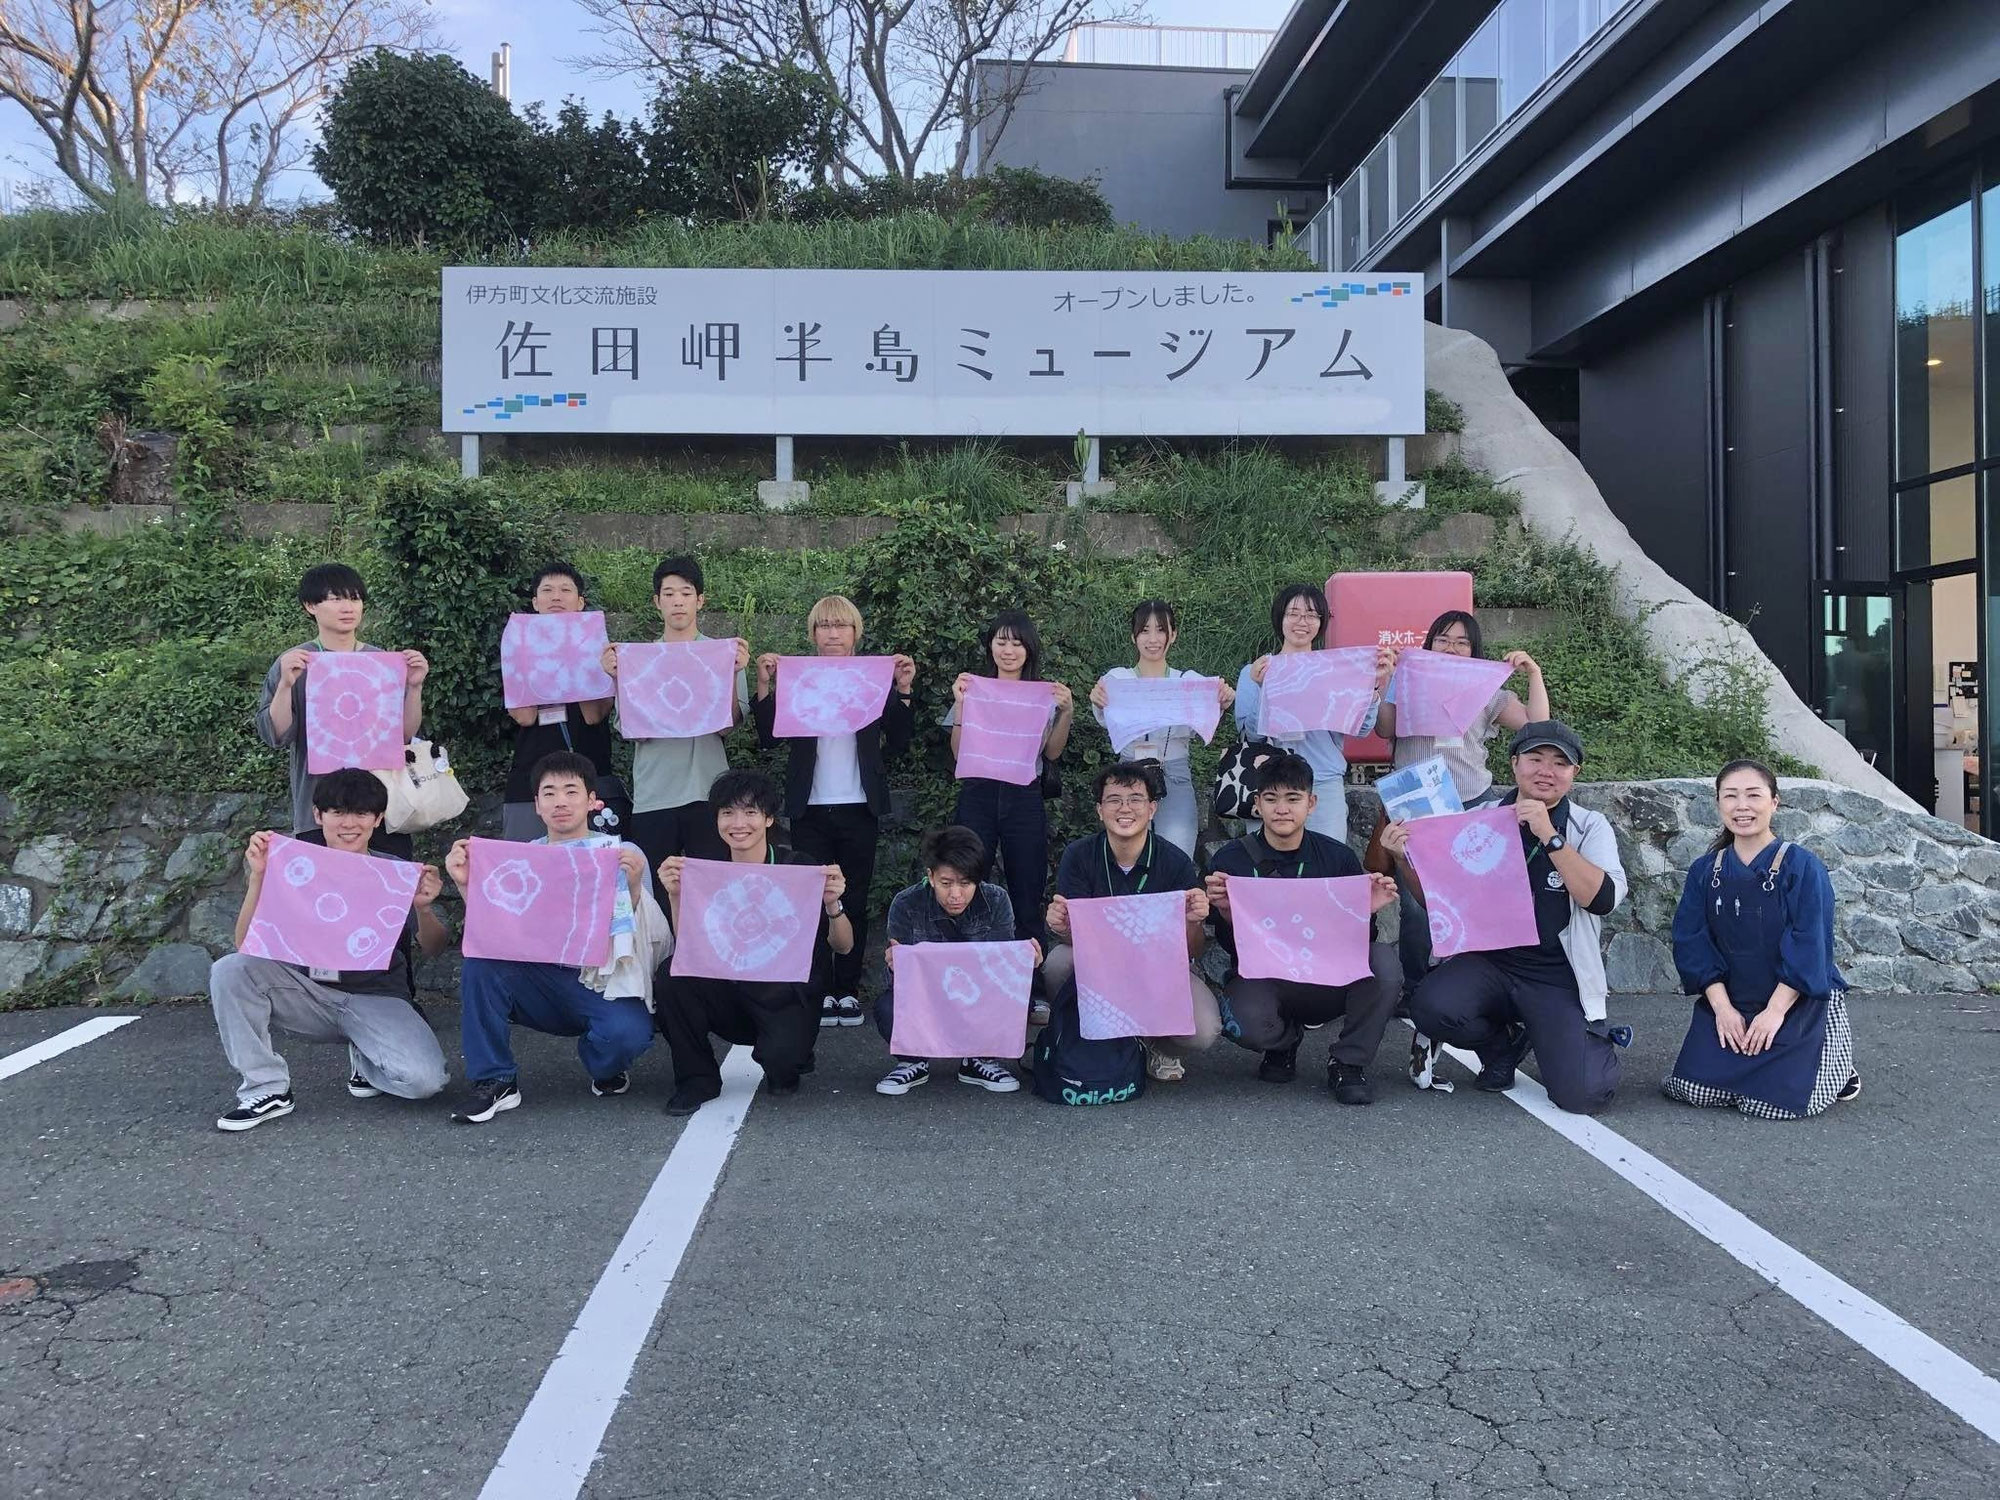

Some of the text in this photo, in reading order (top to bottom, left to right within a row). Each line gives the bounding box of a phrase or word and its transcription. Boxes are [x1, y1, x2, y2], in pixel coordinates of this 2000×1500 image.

[466, 284, 657, 305] 伊方町文化交流施設
[1053, 282, 1255, 312] オープンしました。
[495, 320, 1374, 382] 佐田岬半島ミュージアム
